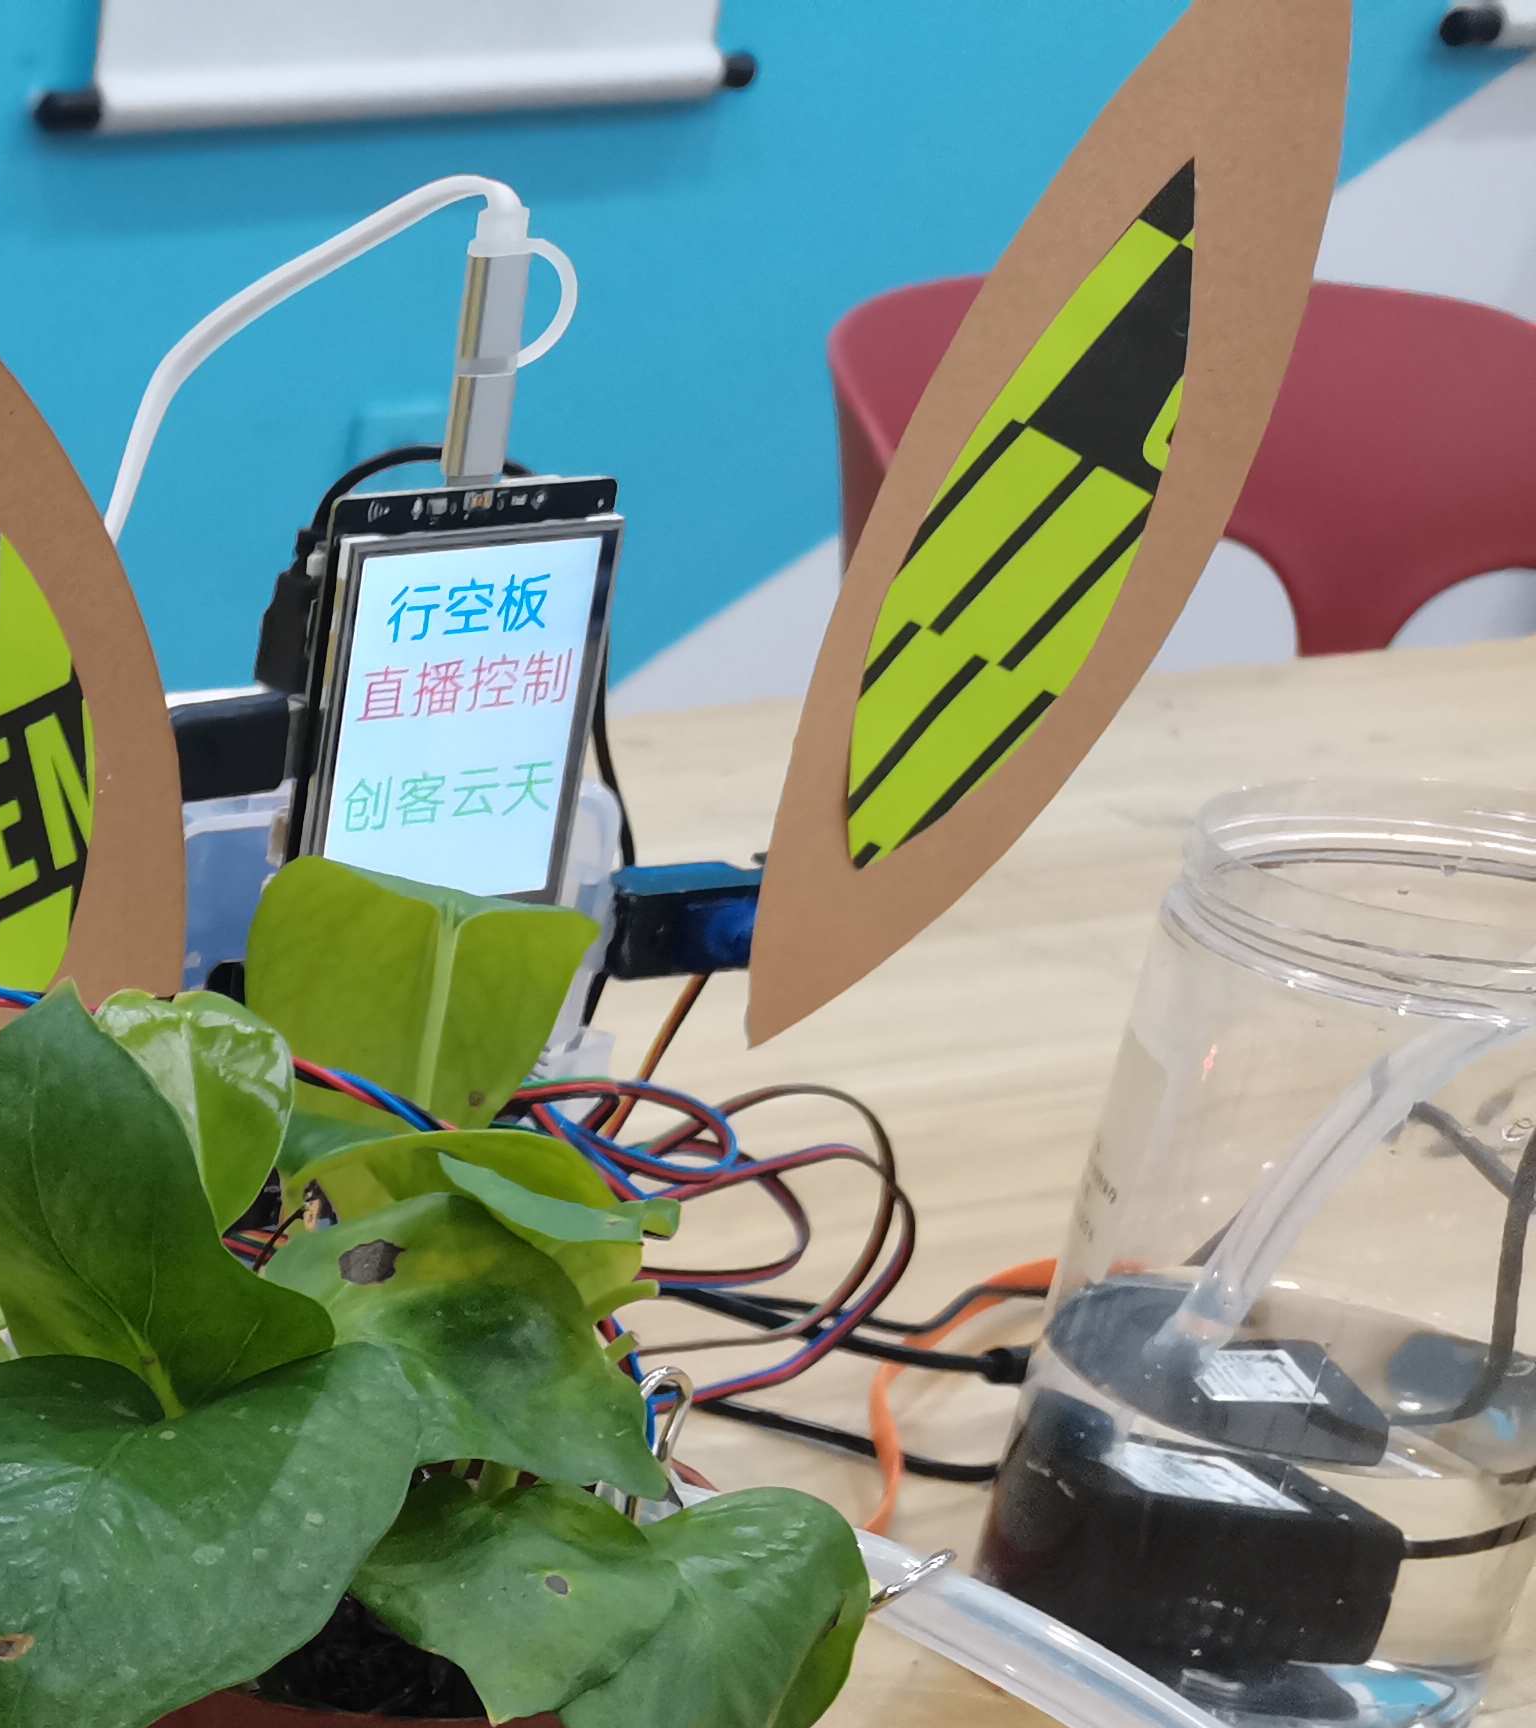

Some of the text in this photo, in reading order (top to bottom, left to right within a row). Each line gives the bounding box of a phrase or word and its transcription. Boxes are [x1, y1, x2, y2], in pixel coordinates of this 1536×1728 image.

[387, 573, 551, 644] 行空板
[354, 647, 573, 723] 直播控制
[345, 760, 555, 832] 创客云天
